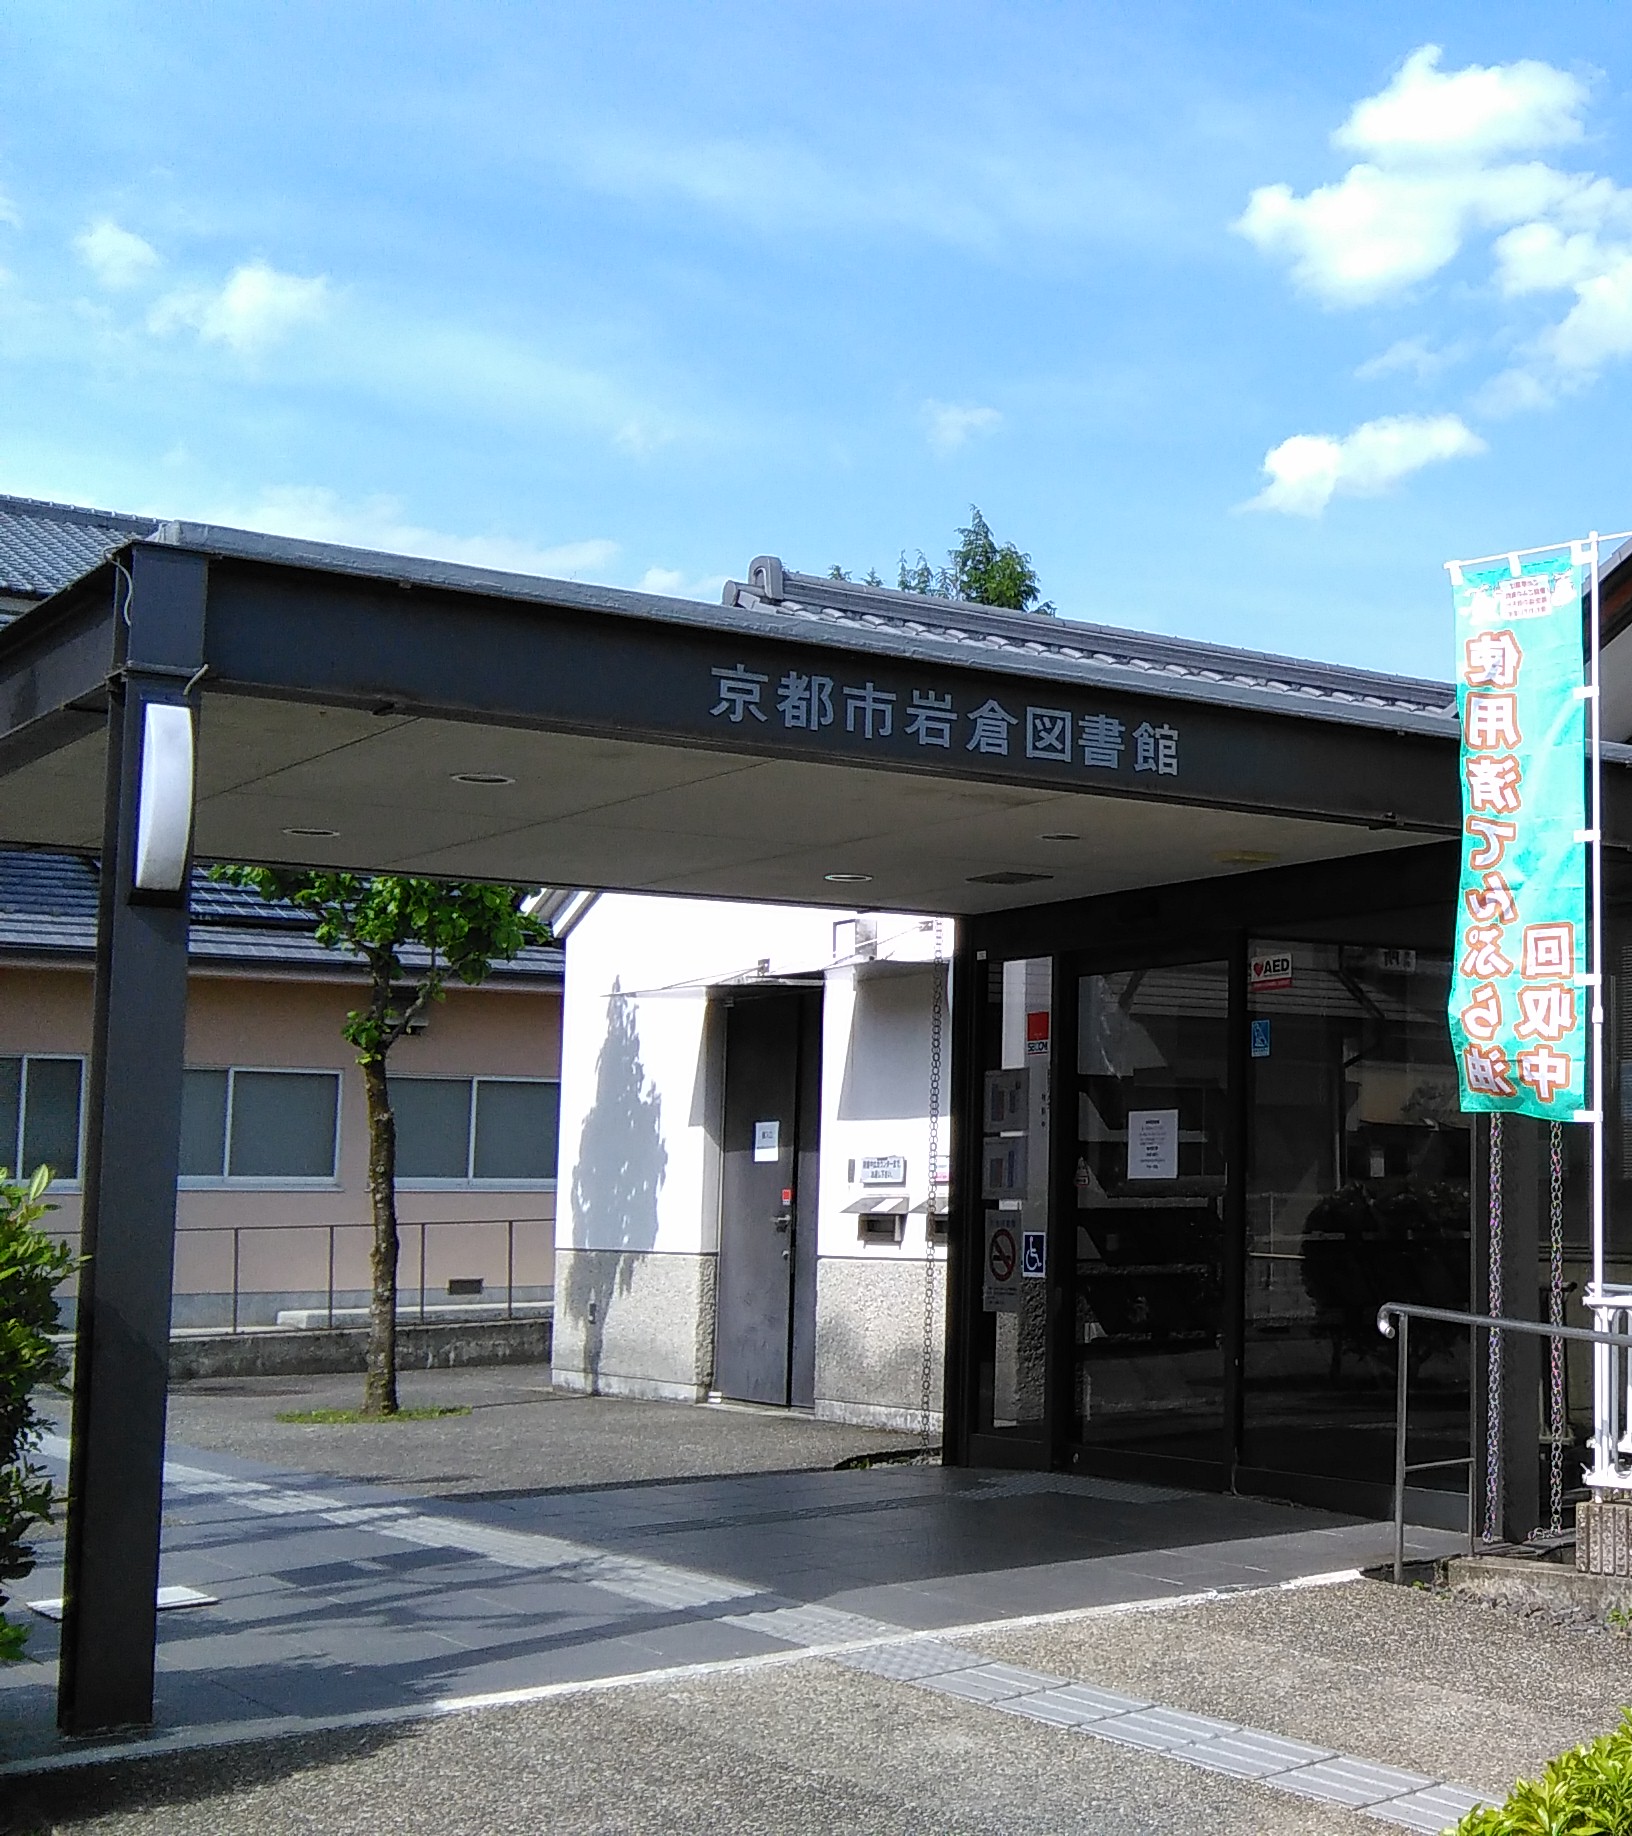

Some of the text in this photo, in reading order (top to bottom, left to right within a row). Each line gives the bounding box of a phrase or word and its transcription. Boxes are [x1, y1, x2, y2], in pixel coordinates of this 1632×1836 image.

[710, 663, 1179, 776] 京都市岩倉図書館
[1264, 958, 1290, 974] AED
